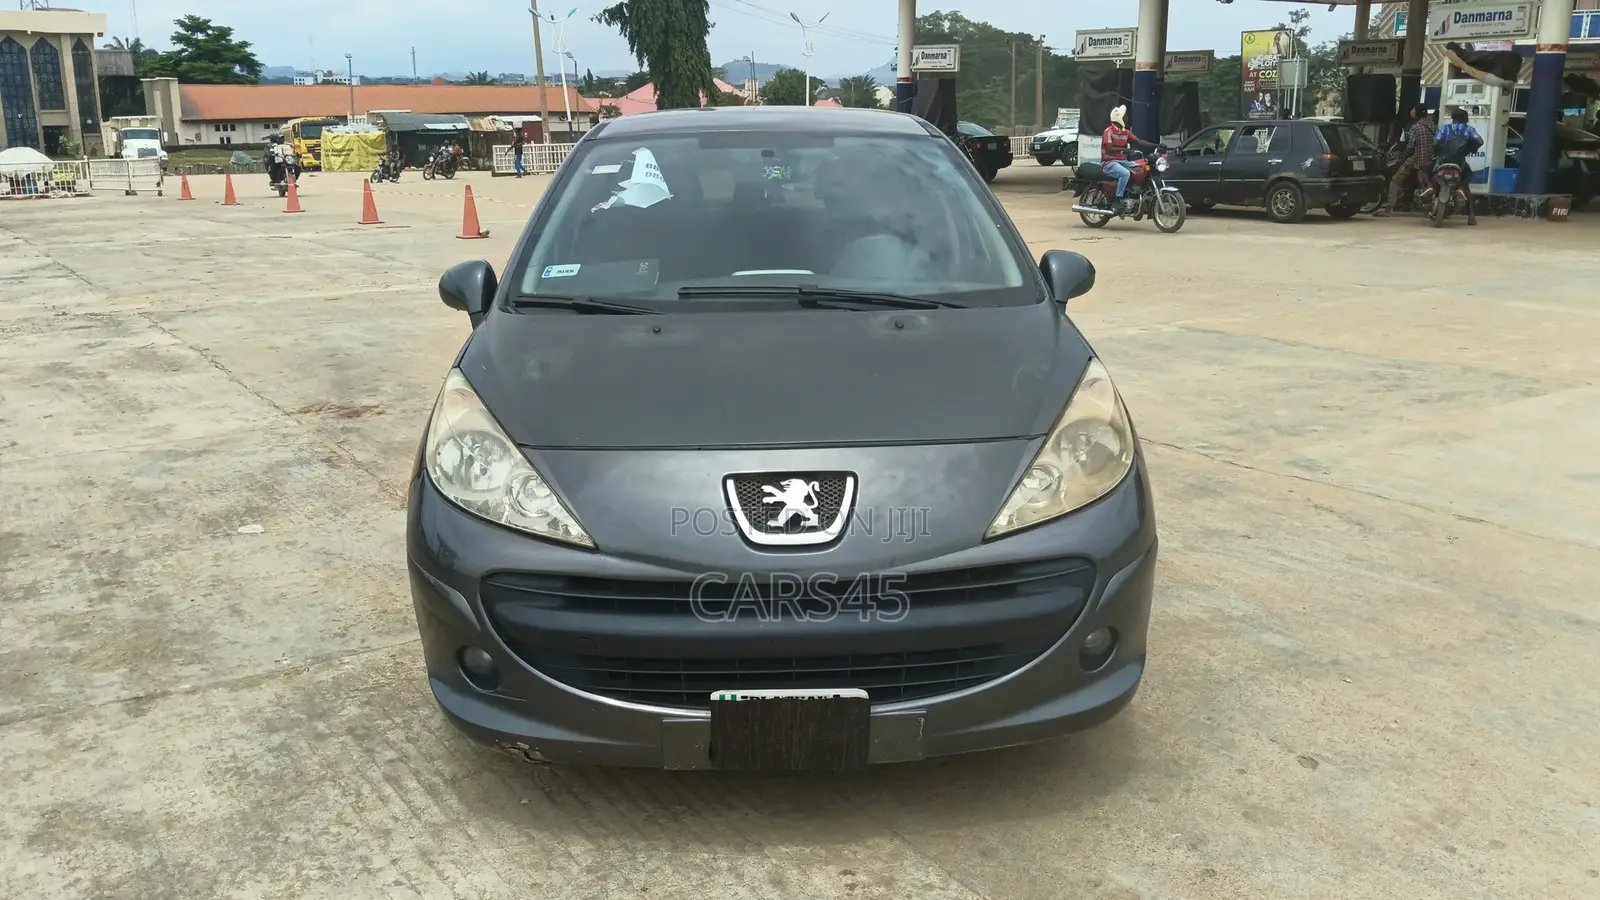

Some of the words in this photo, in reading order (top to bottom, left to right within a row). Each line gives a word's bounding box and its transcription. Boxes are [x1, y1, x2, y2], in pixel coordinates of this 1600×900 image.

[1453, 10, 1513, 25] Danmarna
[1088, 36, 1123, 47] Danmarna
[1351, 45, 1388, 54] Danmarna
[920, 50, 947, 60] Danmarna
[1173, 55, 1202, 63] Danmarna
